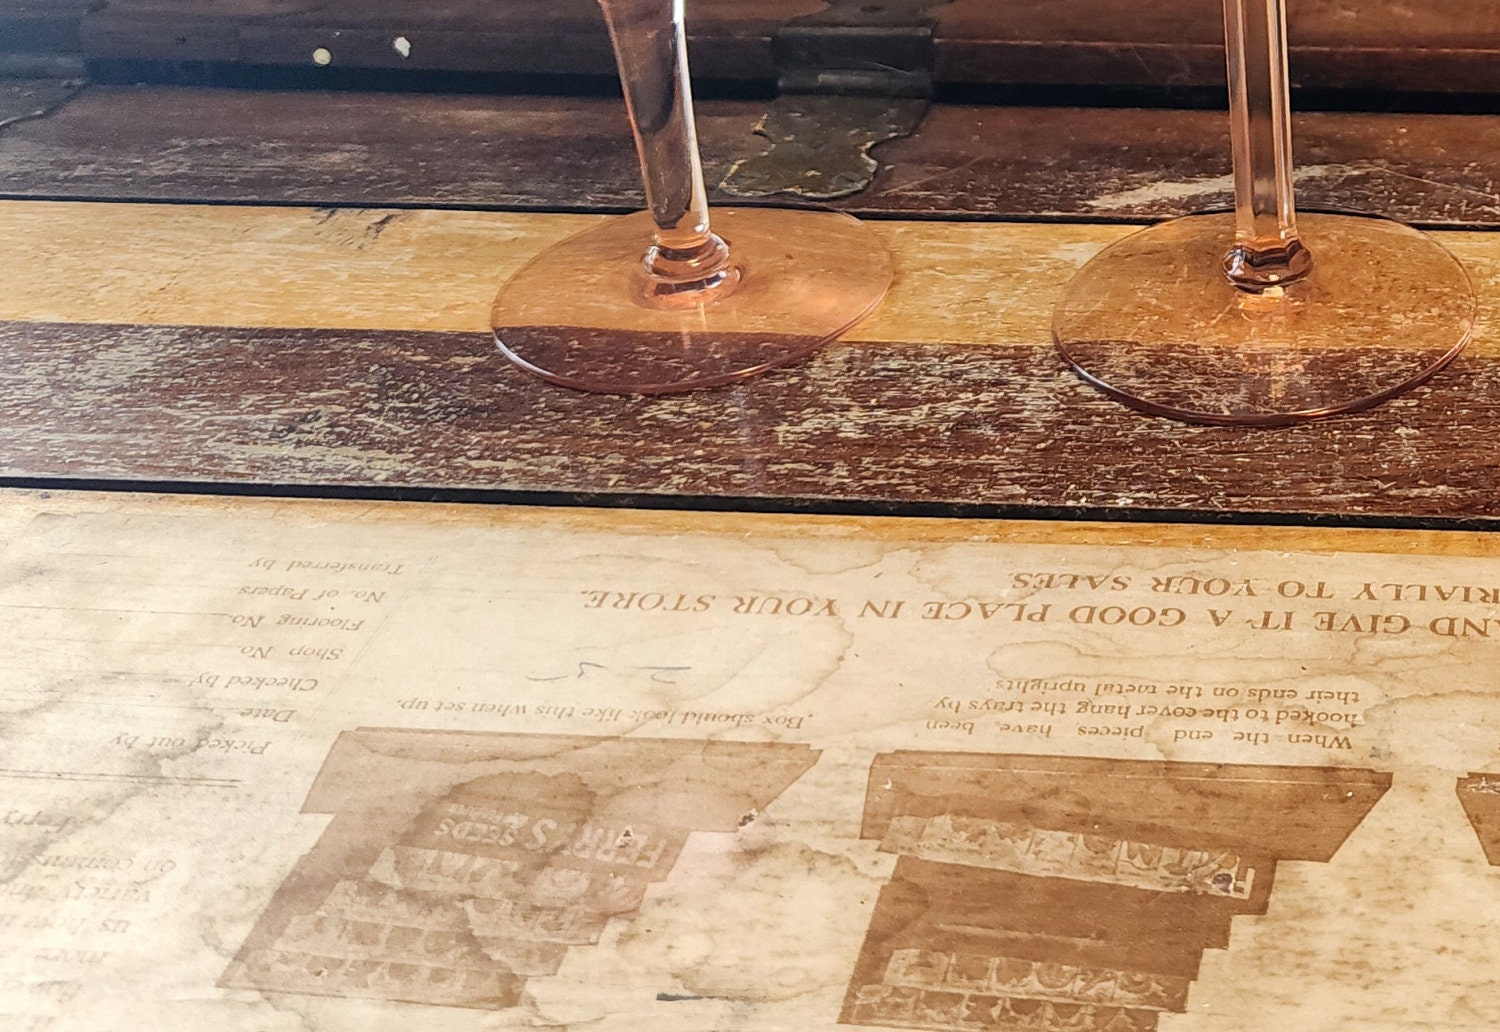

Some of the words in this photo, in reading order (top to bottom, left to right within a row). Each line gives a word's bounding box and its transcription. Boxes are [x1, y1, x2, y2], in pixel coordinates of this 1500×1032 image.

[247, 556, 278, 574] by
[285, 559, 405, 577] Transferred
[235, 583, 311, 602] Papers
[314, 588, 341, 603] of
[1148, 574, 1257, 599] YOUR
[1276, 580, 1336, 601] TO
[349, 589, 388, 604] No.
[579, 589, 718, 615] STORE.
[731, 594, 841, 618] YOUR
[856, 598, 908, 621] IN
[919, 600, 1052, 624] PLACE
[227, 613, 265, 630] No.
[275, 613, 367, 633] Flooring
[1067, 604, 1187, 628] GOOD
[1206, 608, 1234, 629] A
[1249, 609, 1296, 632] IT
[1311, 610, 1413, 636] GIVE
[235, 644, 275, 661] No.
[287, 643, 345, 662] Shop
[188, 670, 221, 690] by
[227, 673, 321, 692] Checked
[1092, 681, 1158, 697] metal
[1166, 683, 1204, 699] the
[1211, 685, 1240, 699] on
[1246, 686, 1299, 702] ends
[1304, 689, 1361, 705] their
[395, 696, 430, 712] up.
[432, 699, 466, 715] set
[470, 700, 528, 718] when
[534, 702, 576, 720] this
[932, 694, 963, 714] by
[967, 696, 1026, 714] trays
[1028, 700, 1068, 716] the
[1075, 699, 1131, 719] hang
[1134, 704, 1198, 719] cover
[238, 706, 298, 724] Date
[581, 705, 622, 723] like
[630, 708, 676, 725] look
[679, 709, 756, 728] should
[762, 713, 805, 730] Box
[1201, 705, 1240, 723] the
[1246, 707, 1270, 724] to
[1274, 707, 1358, 728] hooked
[924, 719, 976, 736] been
[998, 722, 1053, 739] have
[1076, 723, 1146, 742] pieces
[1172, 728, 1214, 744] end
[108, 731, 140, 750] by
[147, 735, 187, 750] out
[198, 737, 273, 756] Picked
[1232, 730, 1272, 747] the
[1286, 730, 1353, 751] When
